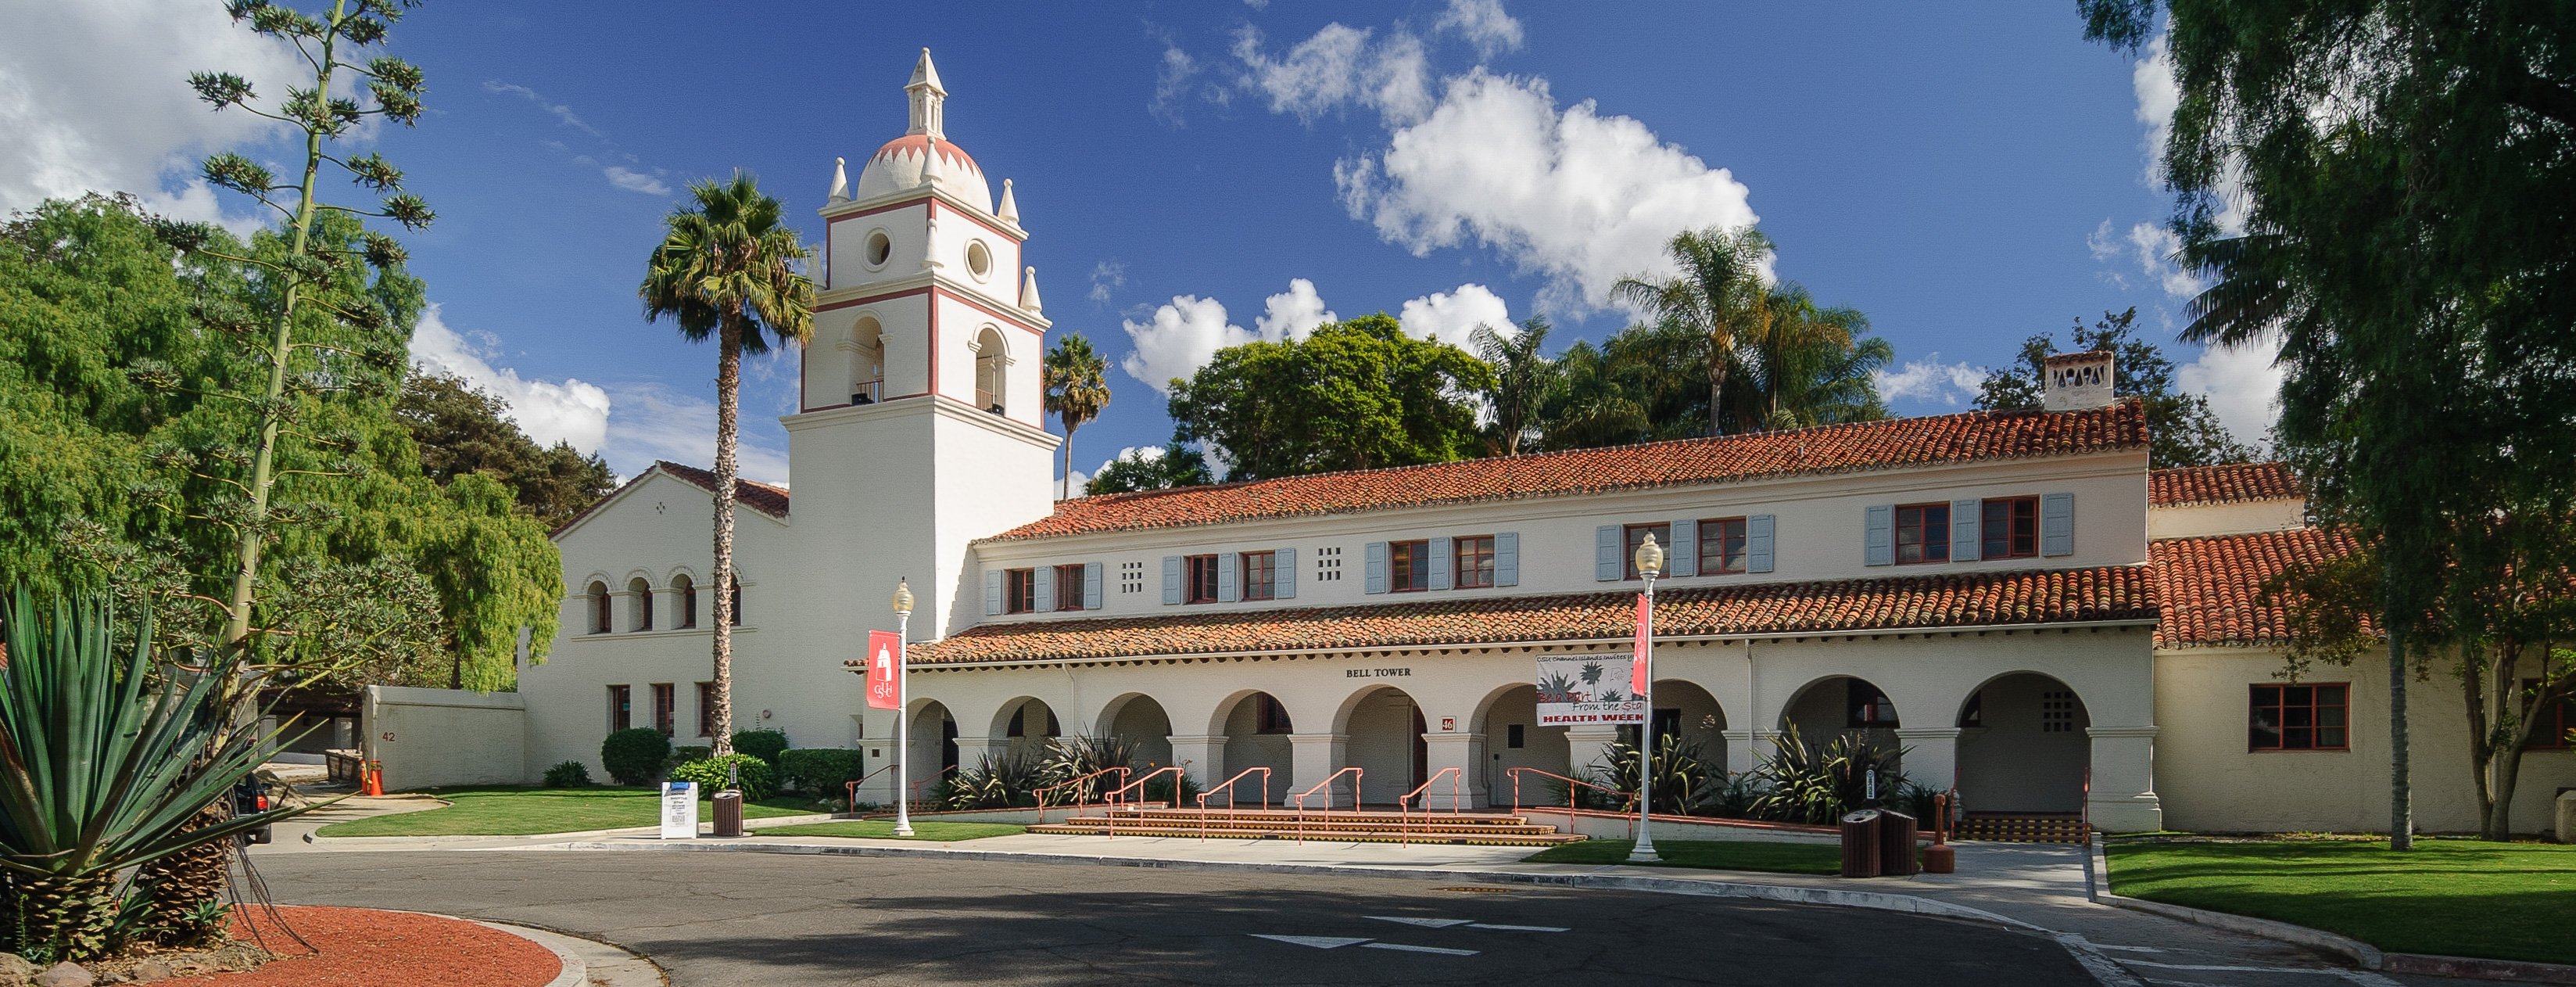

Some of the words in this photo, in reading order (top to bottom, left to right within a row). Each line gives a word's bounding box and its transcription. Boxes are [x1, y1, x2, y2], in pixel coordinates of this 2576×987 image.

[1346, 669, 1371, 677] BELL
[1374, 668, 1411, 677] TOWER
[1538, 692, 1552, 702] Be
[1555, 693, 1563, 702] a
[1566, 691, 1592, 702] Part
[1572, 702, 1600, 711] From
[1603, 701, 1619, 711] the
[1621, 702, 1643, 710] Sta
[1442, 720, 1453, 729] 46
[382, 731, 395, 741] 42
